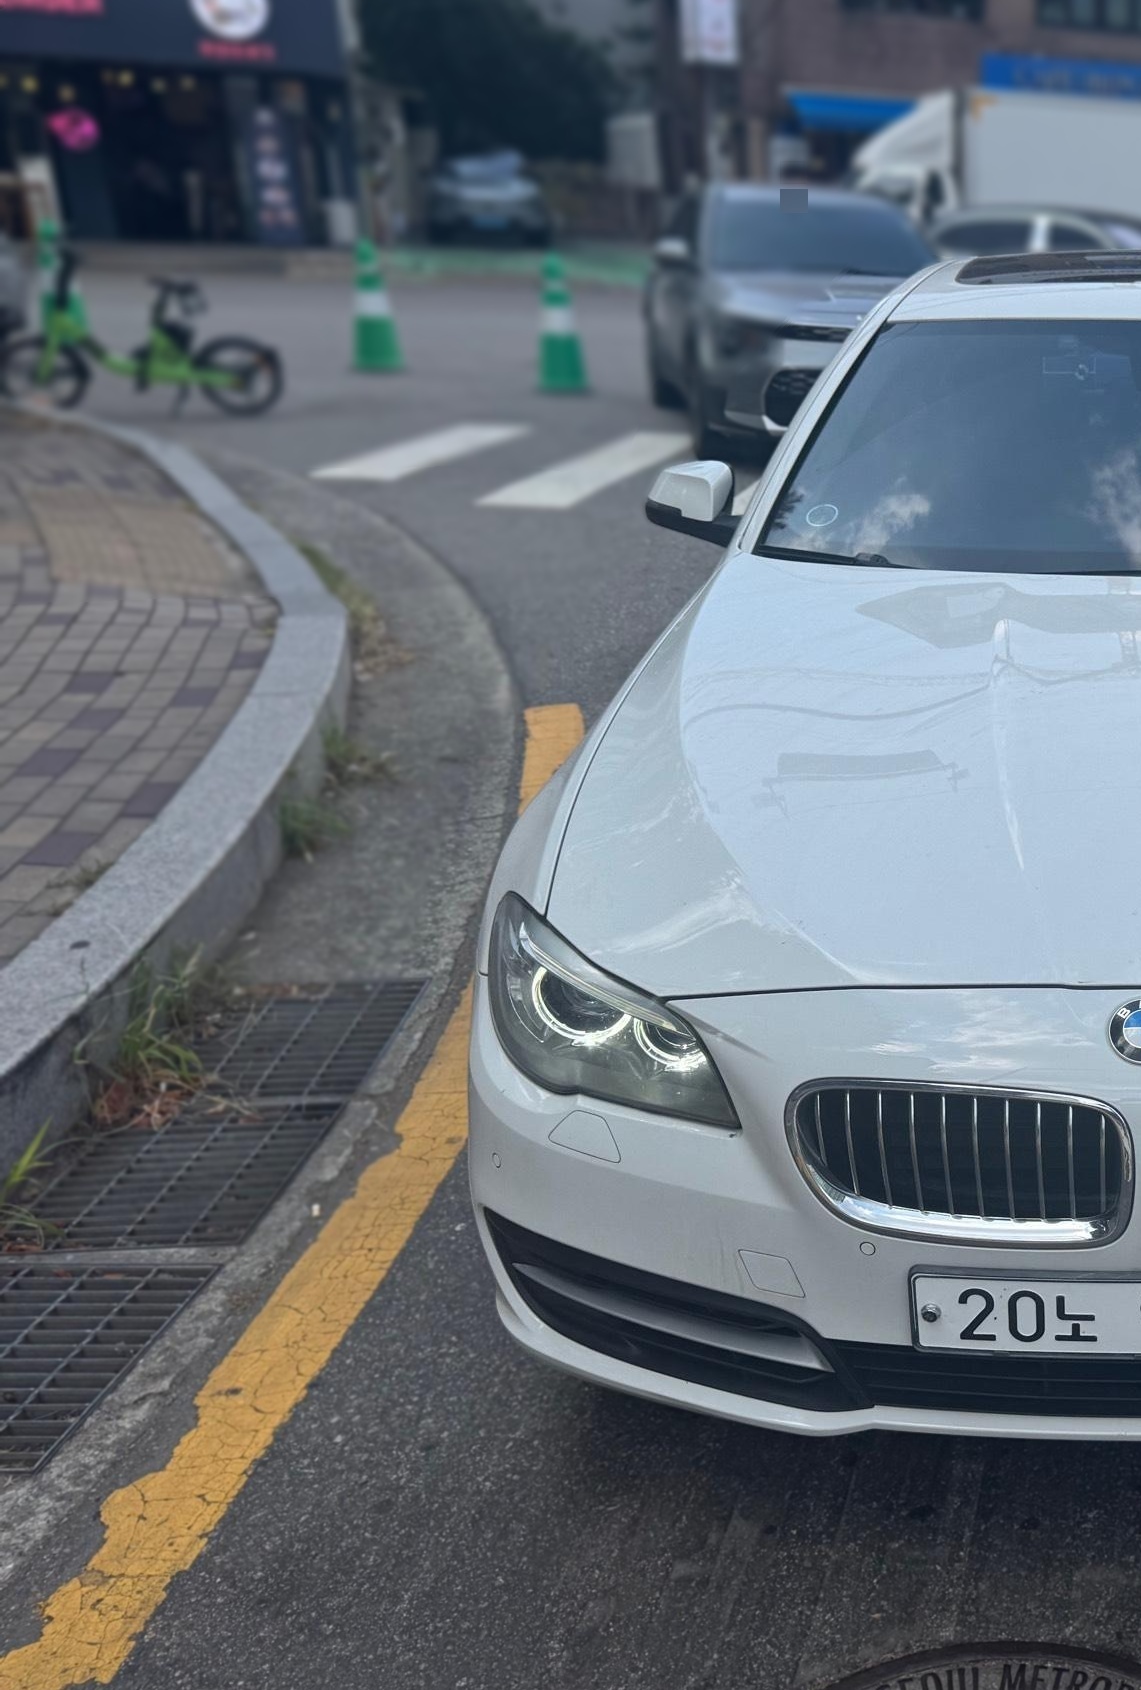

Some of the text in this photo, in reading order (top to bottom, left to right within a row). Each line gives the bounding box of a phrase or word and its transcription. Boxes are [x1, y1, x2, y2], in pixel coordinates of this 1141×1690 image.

[958, 1288, 1098, 1342] 20노
[875, 1663, 1137, 1690] OUL METR
